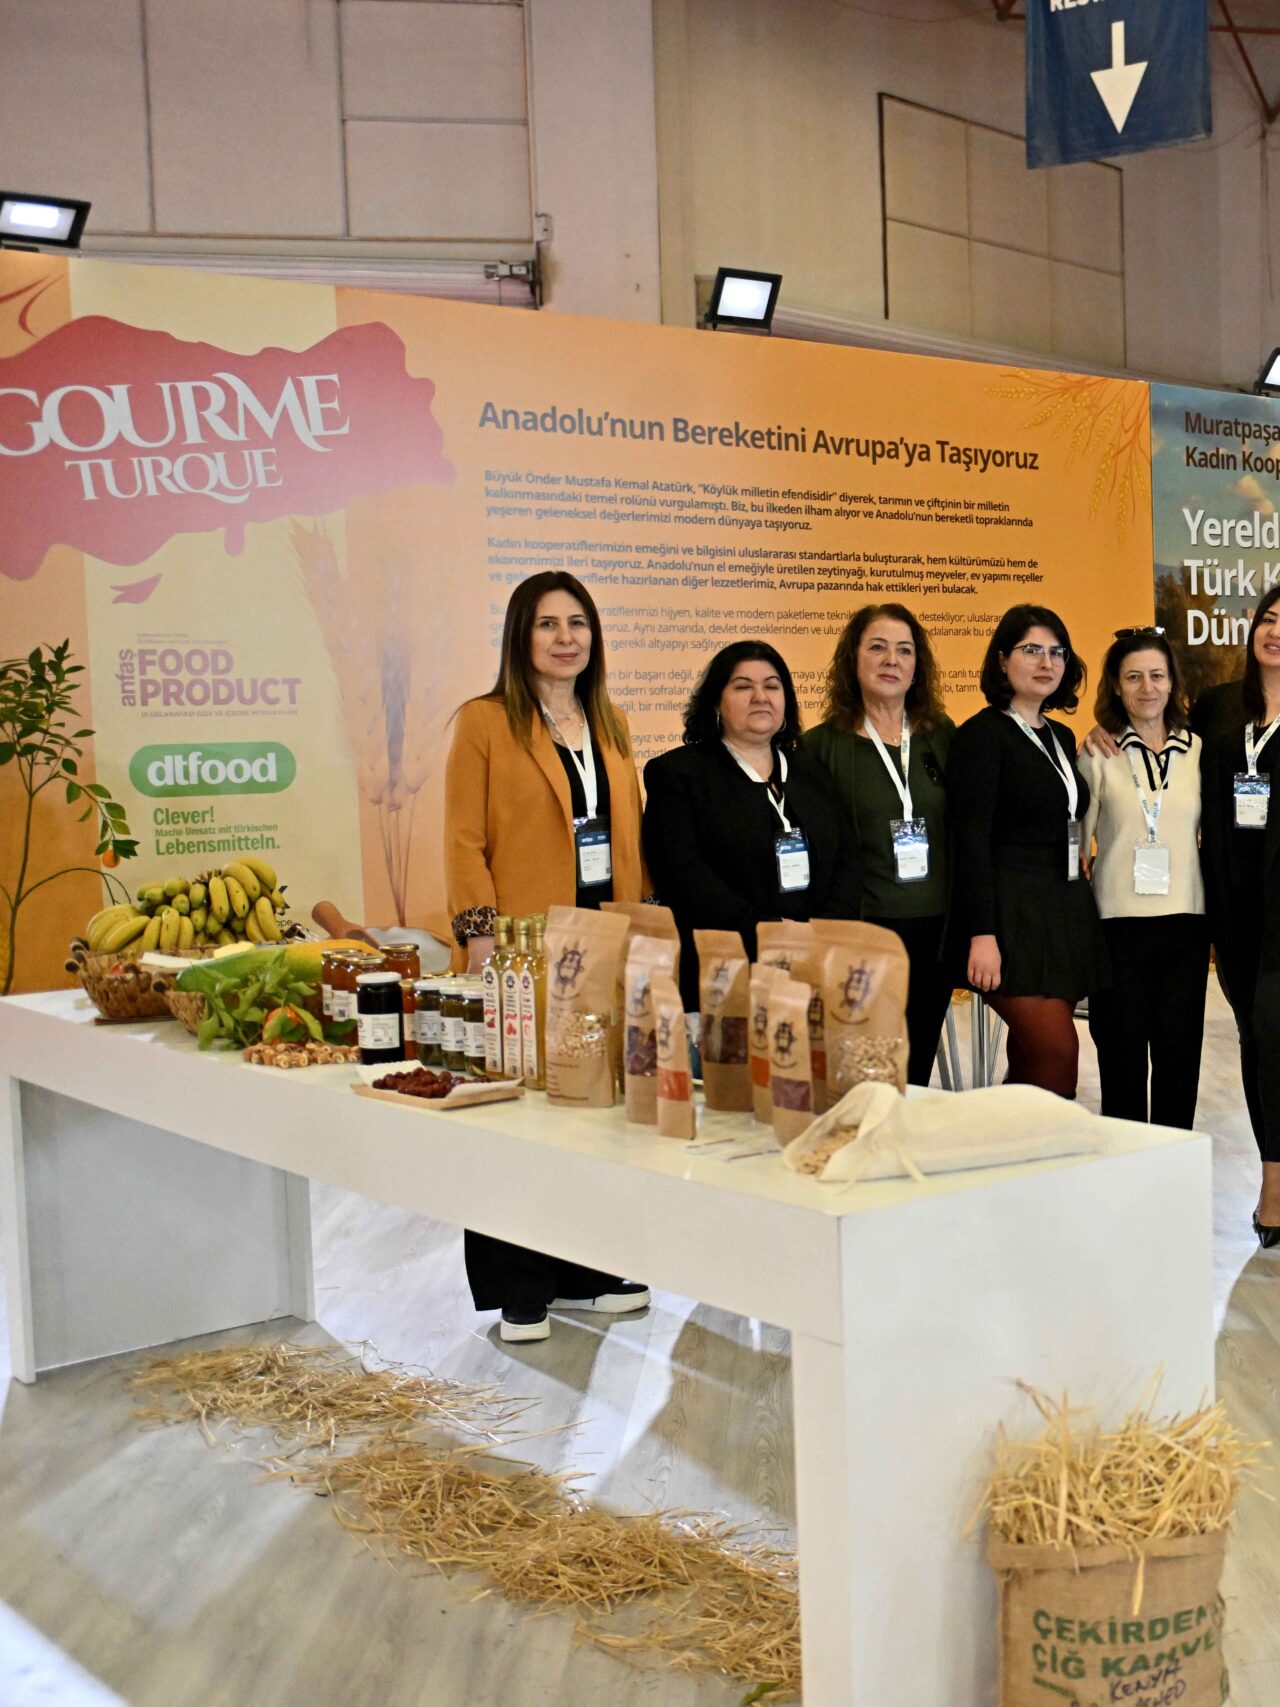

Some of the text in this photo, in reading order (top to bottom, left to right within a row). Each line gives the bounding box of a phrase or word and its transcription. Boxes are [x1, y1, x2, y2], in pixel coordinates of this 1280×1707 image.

[0, 372, 350, 456] GOURME
[478, 400, 1040, 474] Anadolu'nun Bereketini Avrupa'ya Taşıyoruz
[1185, 446, 1237, 471] Kadın
[64, 448, 283, 504] TURQUE
[484, 469, 522, 485] Büyük
[525, 472, 562, 485] Önder
[565, 475, 612, 488] Mustafa
[614, 478, 650, 490] Kemal
[740, 486, 780, 498] milletin
[878, 494, 913, 506] tarımın
[914, 497, 926, 506] ve
[926, 496, 962, 511] çiftçinin
[964, 498, 975, 509] bir
[977, 499, 1010, 511] milletin
[535, 506, 597, 522] geleneksel
[599, 509, 672, 526] değerlerimizi
[674, 513, 716, 525] modern
[718, 515, 762, 530] dünyaya
[584, 492, 618, 504] temel
[620, 494, 657, 506] rolünü
[750, 501, 764, 512] bu
[766, 502, 802, 514] ilkeden
[804, 504, 832, 516] ilham
[834, 505, 861, 520] alıyor
[862, 509, 874, 518] ve
[935, 511, 974, 523] bereketli
[976, 513, 1034, 530] topraklarında
[524, 538, 633, 555] kooperatiflerimizin
[634, 542, 679, 556] emeğini
[682, 546, 694, 554] ve
[696, 544, 736, 559] bilgisini
[738, 546, 797, 559] uluslararası
[799, 548, 861, 561] standartlarla
[926, 554, 948, 565] hem
[948, 555, 1006, 568] kültürümüzü
[1007, 557, 1026, 568] hem
[1027, 558, 1038, 569] de
[567, 556, 588, 567] ileri
[716, 561, 726, 572] el
[728, 561, 774, 576] emeğiyle
[817, 564, 867, 579] zeytinyağı,
[926, 568, 968, 583] meyveler,
[970, 572, 981, 581] ev
[982, 573, 1012, 584] yapımı
[1012, 572, 1044, 586] reçeller
[621, 574, 679, 586] hazırlanan
[681, 576, 709, 589] diğer
[779, 578, 815, 592] Avrupa
[816, 579, 864, 594] pazarında
[866, 581, 884, 592] hak
[886, 581, 922, 593] ettikleri
[923, 582, 940, 596] yeri
[1184, 559, 1256, 597] Türk
[138, 648, 234, 676] FOOD
[139, 678, 302, 706] PRODUCT
[147, 751, 278, 787] dtfood
[153, 805, 216, 826] Clever!
[186, 826, 216, 836] Umsatz
[218, 825, 232, 834] mit
[155, 834, 280, 856] Lebensmitteln.
[1101, 1627, 1216, 1678] KAHVE
